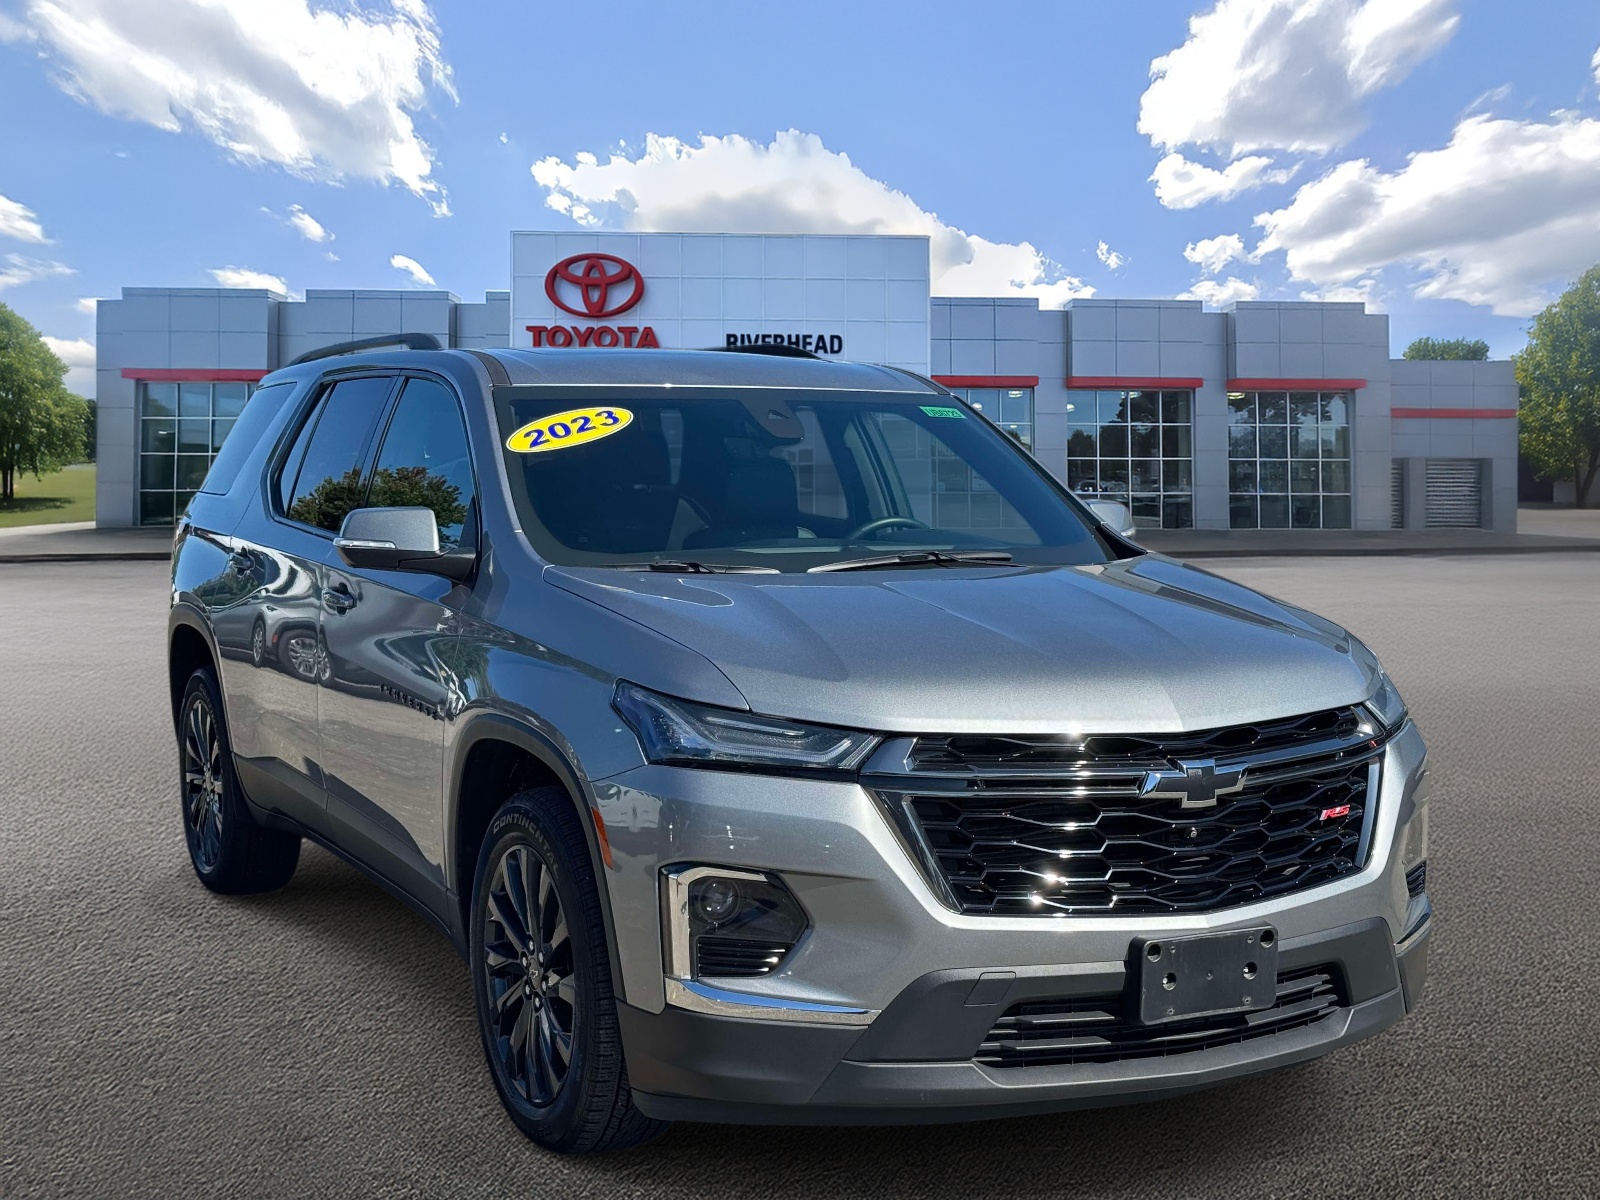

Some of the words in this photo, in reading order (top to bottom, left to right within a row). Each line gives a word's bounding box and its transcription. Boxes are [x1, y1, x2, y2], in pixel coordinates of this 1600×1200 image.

[526, 325, 660, 348] TOYOTA
[523, 410, 621, 449] 2023
[1320, 804, 1350, 820] RS
